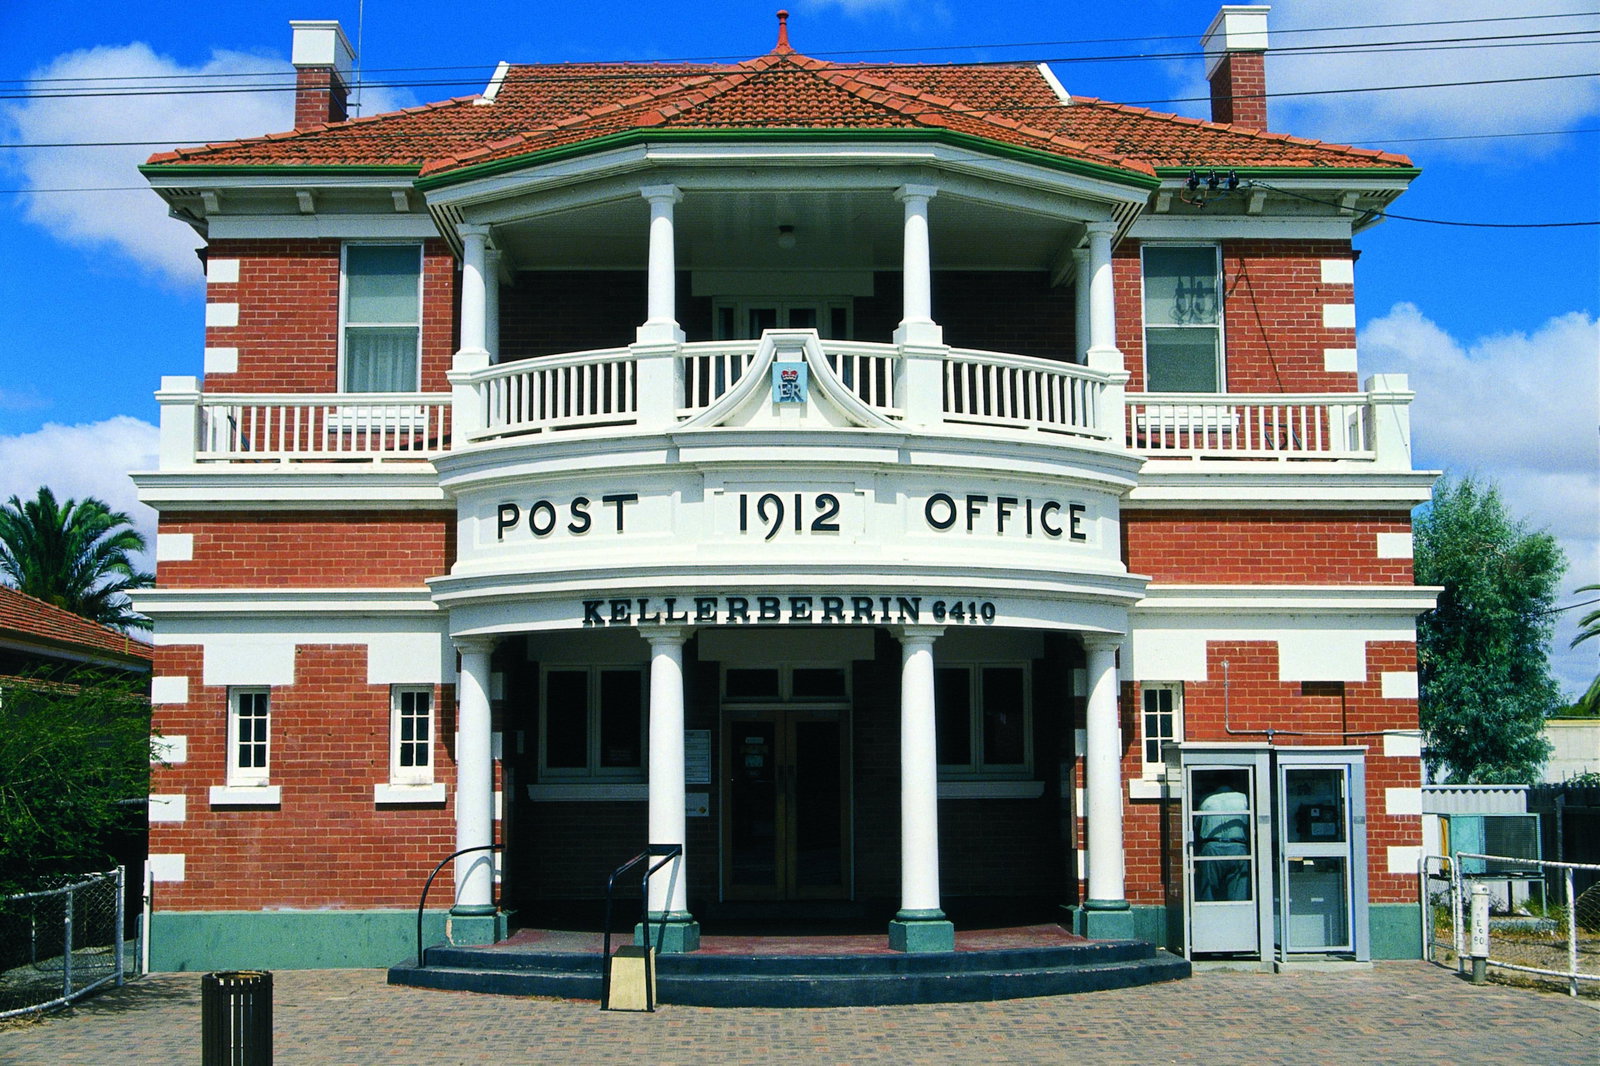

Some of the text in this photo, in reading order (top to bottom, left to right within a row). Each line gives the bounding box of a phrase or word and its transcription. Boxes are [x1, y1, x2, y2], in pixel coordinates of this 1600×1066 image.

[497, 492, 1087, 540] POST 1912 OFFICE
[582, 596, 996, 624] KELLERBERRIN 6410
